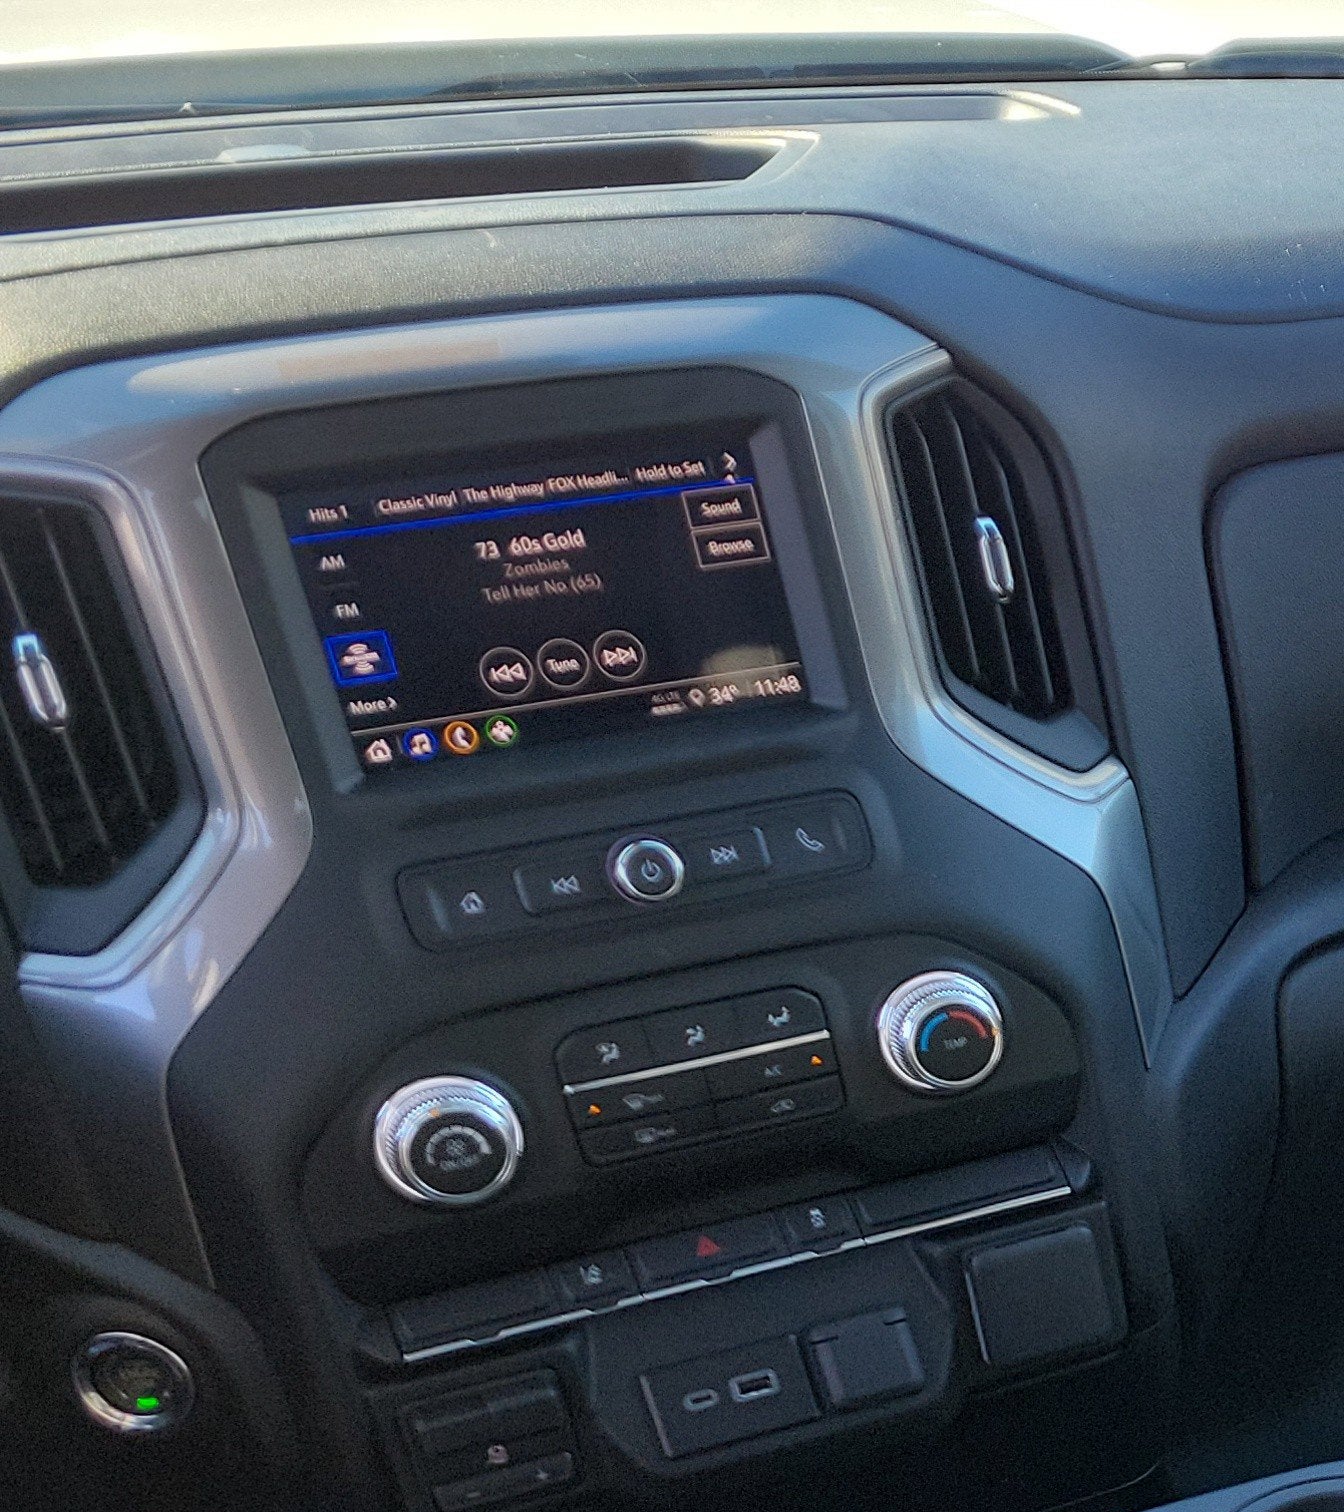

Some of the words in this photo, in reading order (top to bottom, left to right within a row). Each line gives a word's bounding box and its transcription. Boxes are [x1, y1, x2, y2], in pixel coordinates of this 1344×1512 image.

[635, 464, 667, 481] Hold
[668, 464, 683, 478] to
[682, 460, 706, 476] Set
[463, 487, 489, 503] The
[490, 482, 545, 501] Highway
[548, 476, 577, 492] FOX
[378, 495, 425, 514] Classic
[425, 490, 459, 508] Vinyl
[701, 498, 742, 516] Sound
[308, 507, 338, 523] Hits
[475, 540, 501, 560] 73
[508, 536, 543, 557] 60s
[543, 528, 587, 551] Gold
[707, 538, 754, 557] Browse
[320, 554, 346, 571] AM
[503, 557, 571, 578] Zombies
[481, 584, 511, 603] Tell
[513, 582, 541, 599] Her
[544, 579, 567, 595] No
[570, 572, 604, 593] (65)
[335, 602, 360, 619] FM
[546, 657, 581, 675] Tune
[348, 698, 387, 716] More
